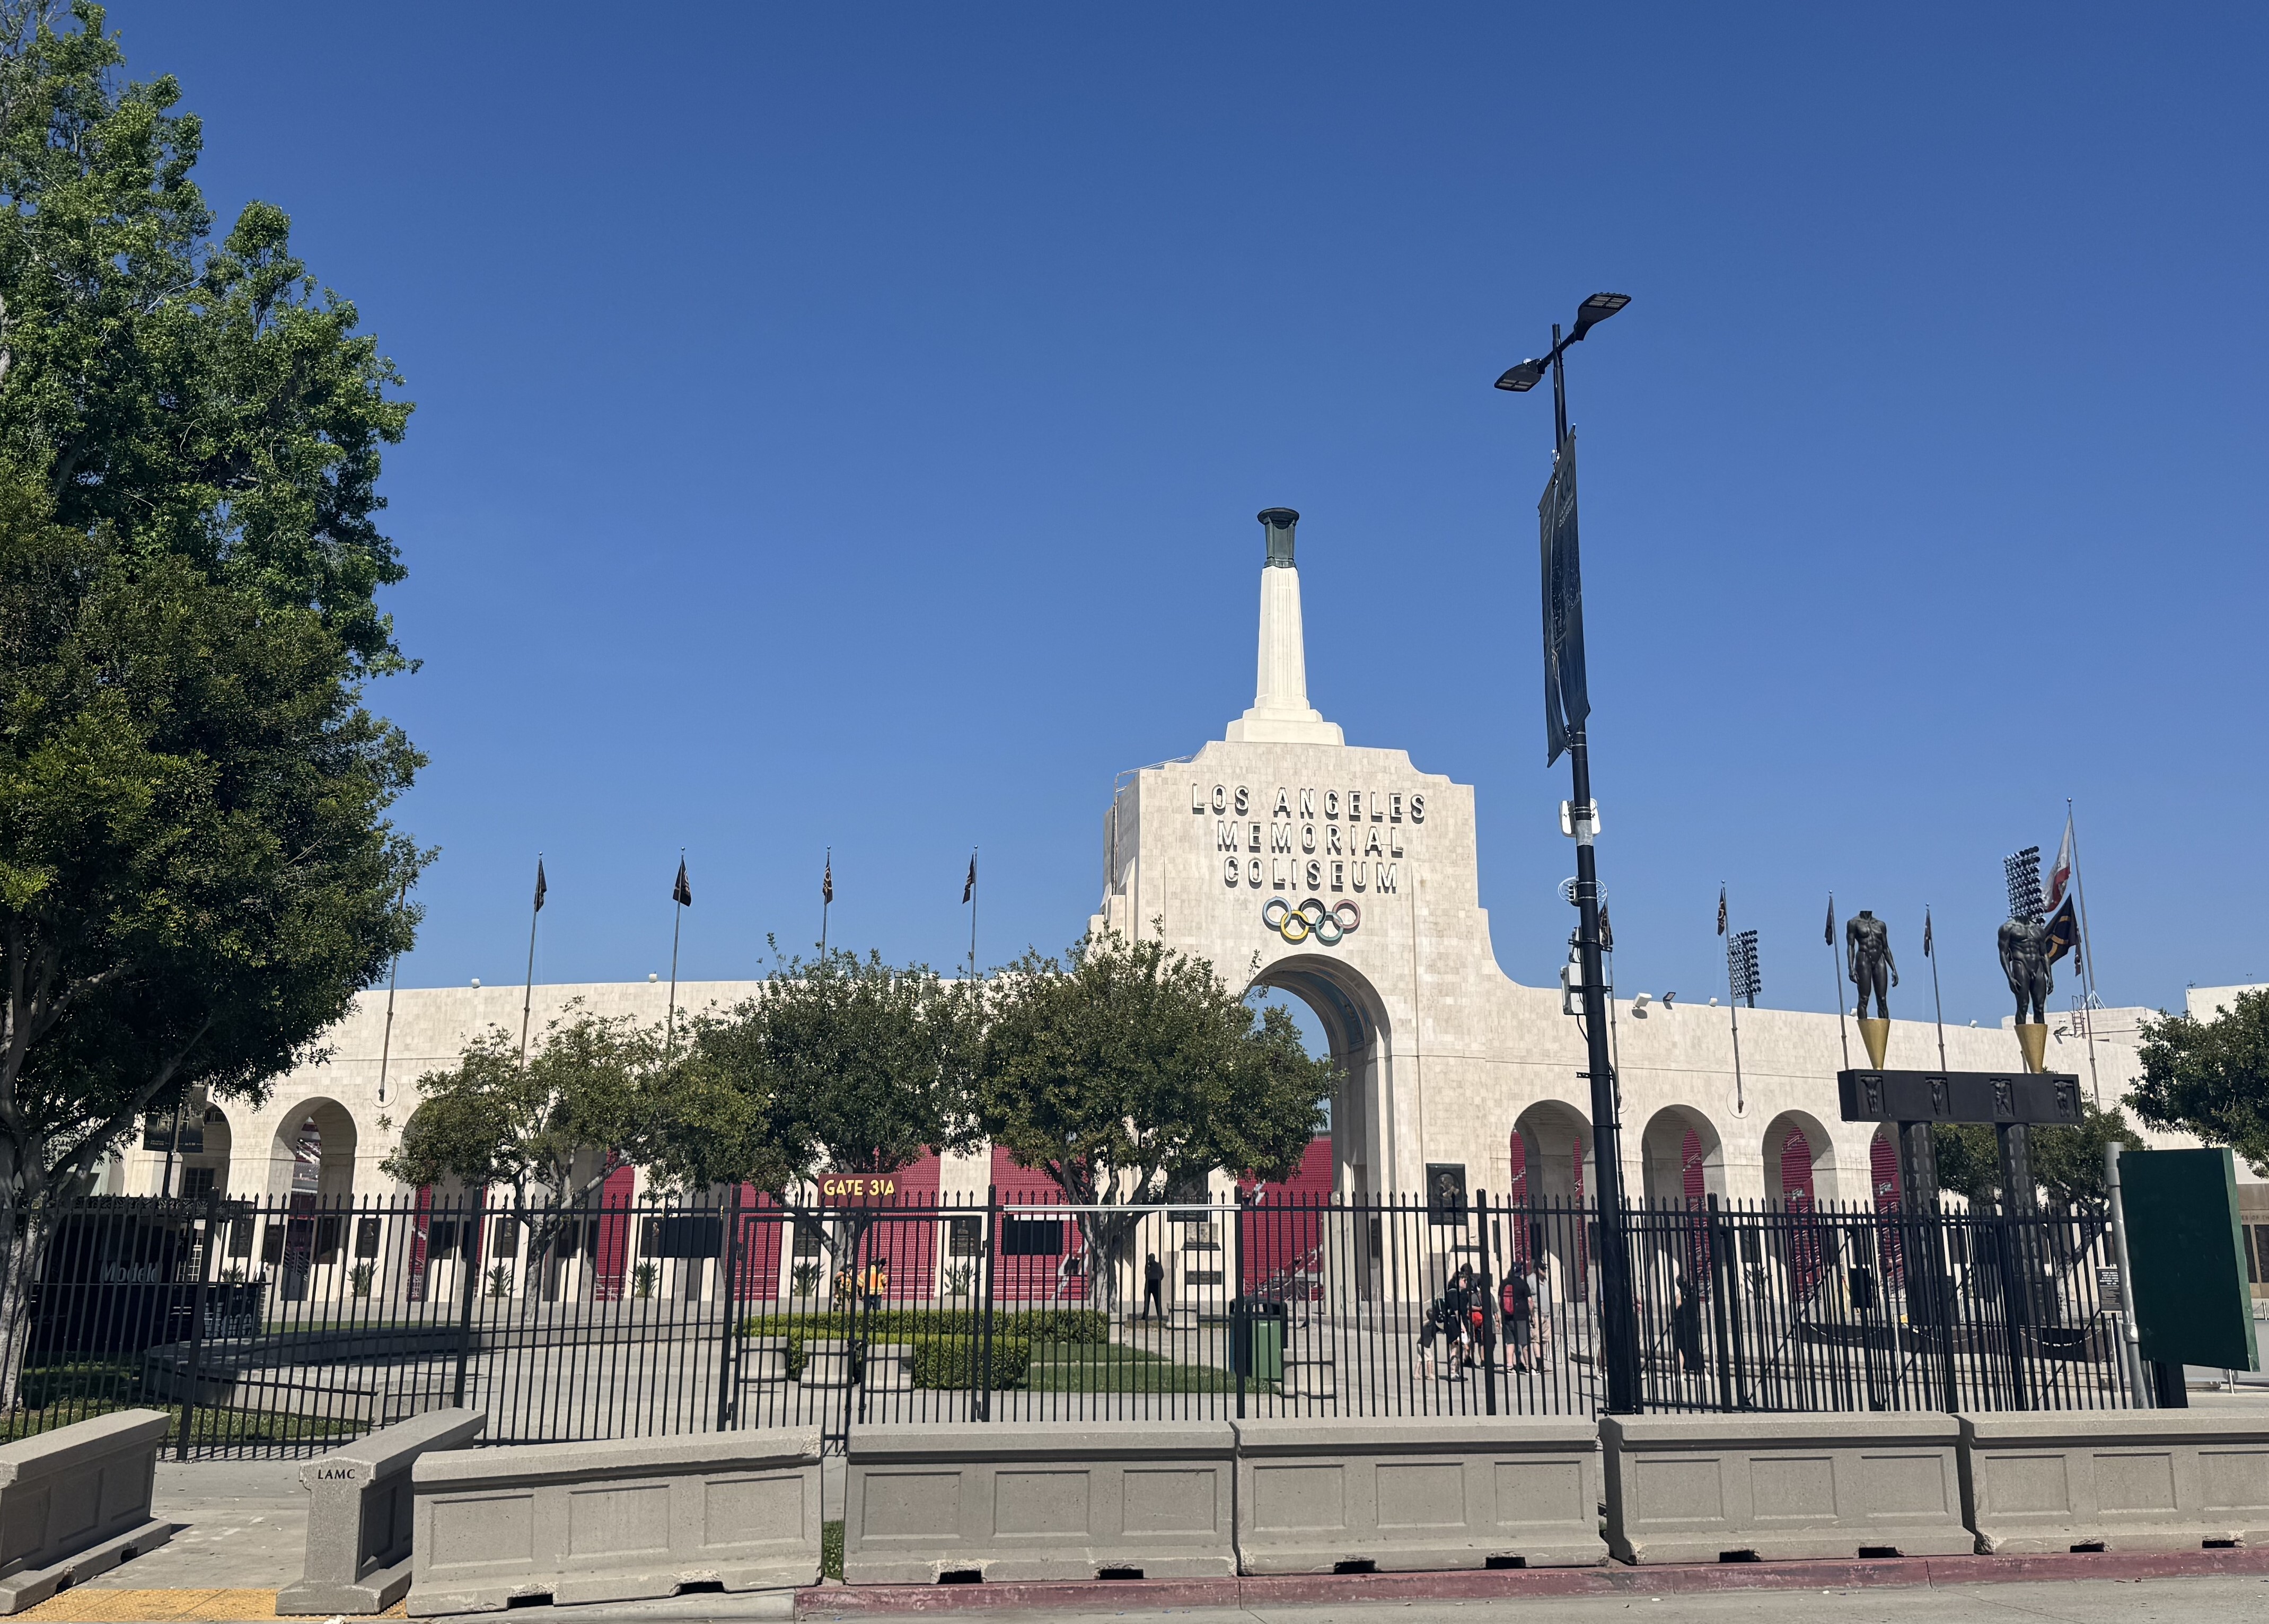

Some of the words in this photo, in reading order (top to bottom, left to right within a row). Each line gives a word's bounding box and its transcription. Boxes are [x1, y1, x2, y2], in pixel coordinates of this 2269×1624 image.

[1192, 783, 1249, 813] LOS
[1273, 787, 1424, 821] ANGELES
[1218, 820, 1403, 855] MEMORIAL
[1224, 856, 1397, 890] COLISEUM
[823, 1179, 864, 1196] GATE
[869, 1179, 895, 1196] 31A
[318, 1469, 355, 1479] LAMC
